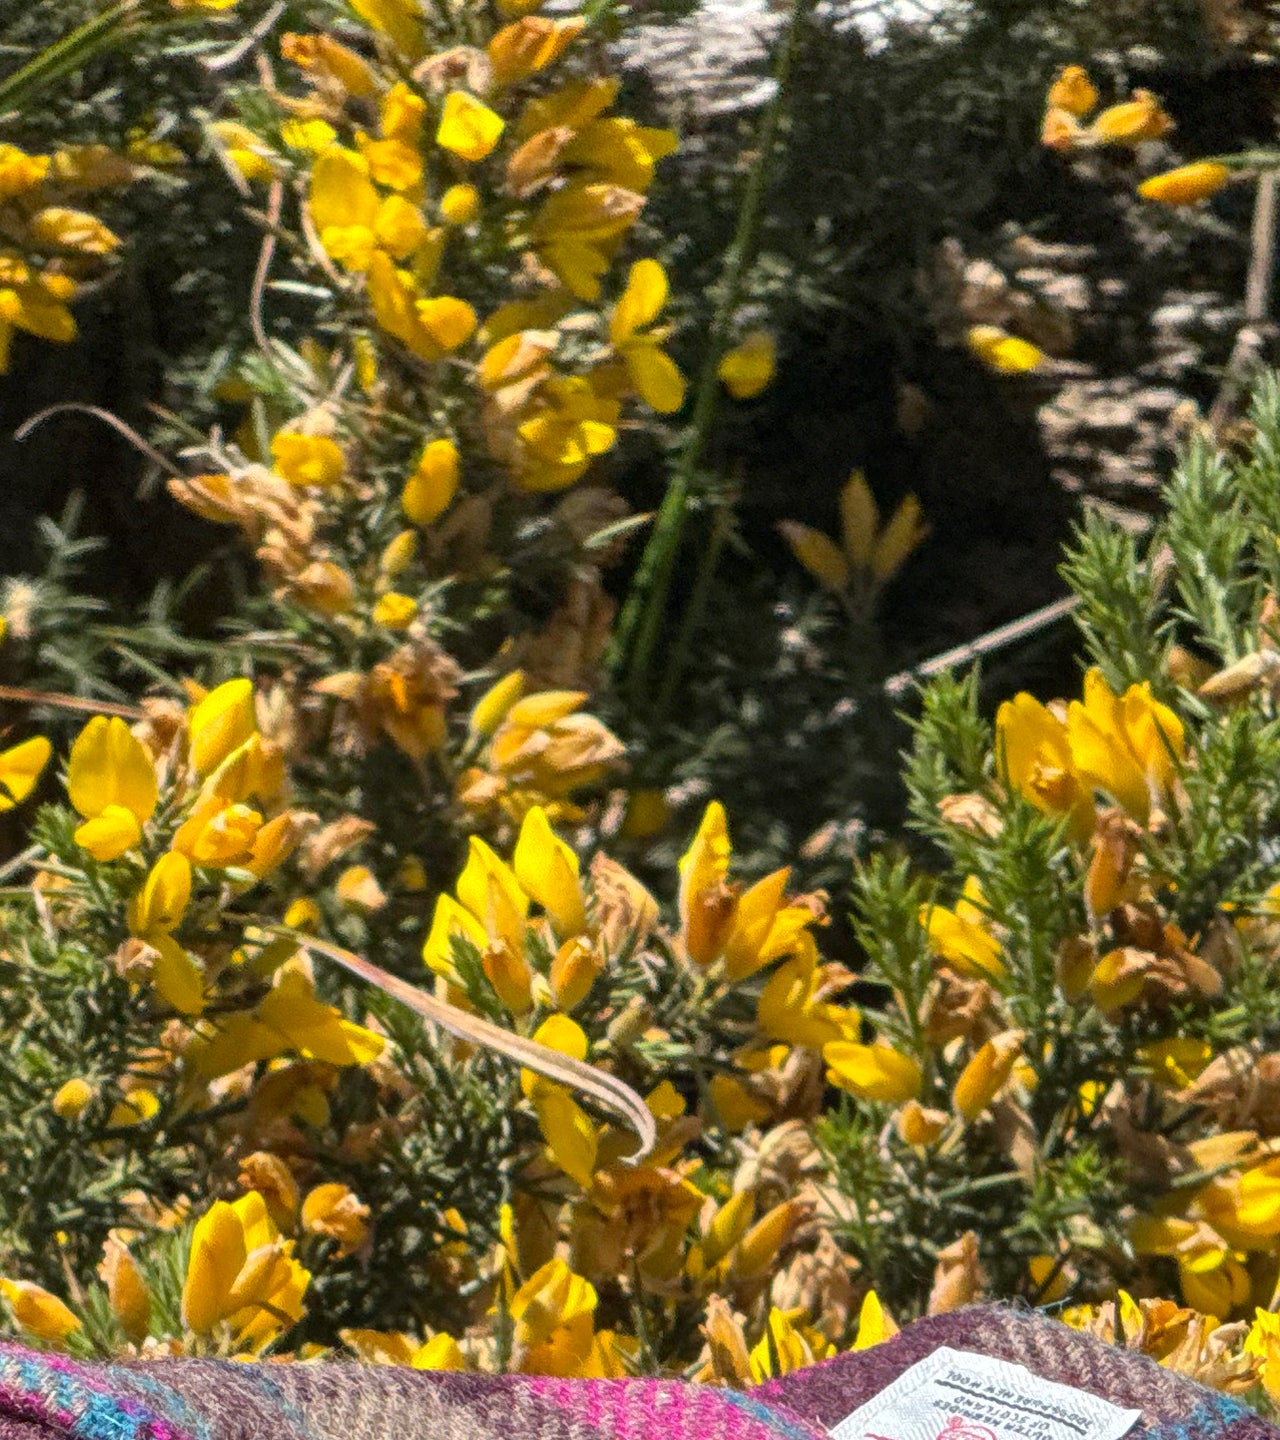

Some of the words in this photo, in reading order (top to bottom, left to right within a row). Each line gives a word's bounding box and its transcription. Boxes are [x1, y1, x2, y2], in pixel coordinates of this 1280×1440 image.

[945, 1370, 983, 1389] WOOL
[953, 1395, 1030, 1424] SCOTLAND
[1030, 1419, 1051, 1431] OF
